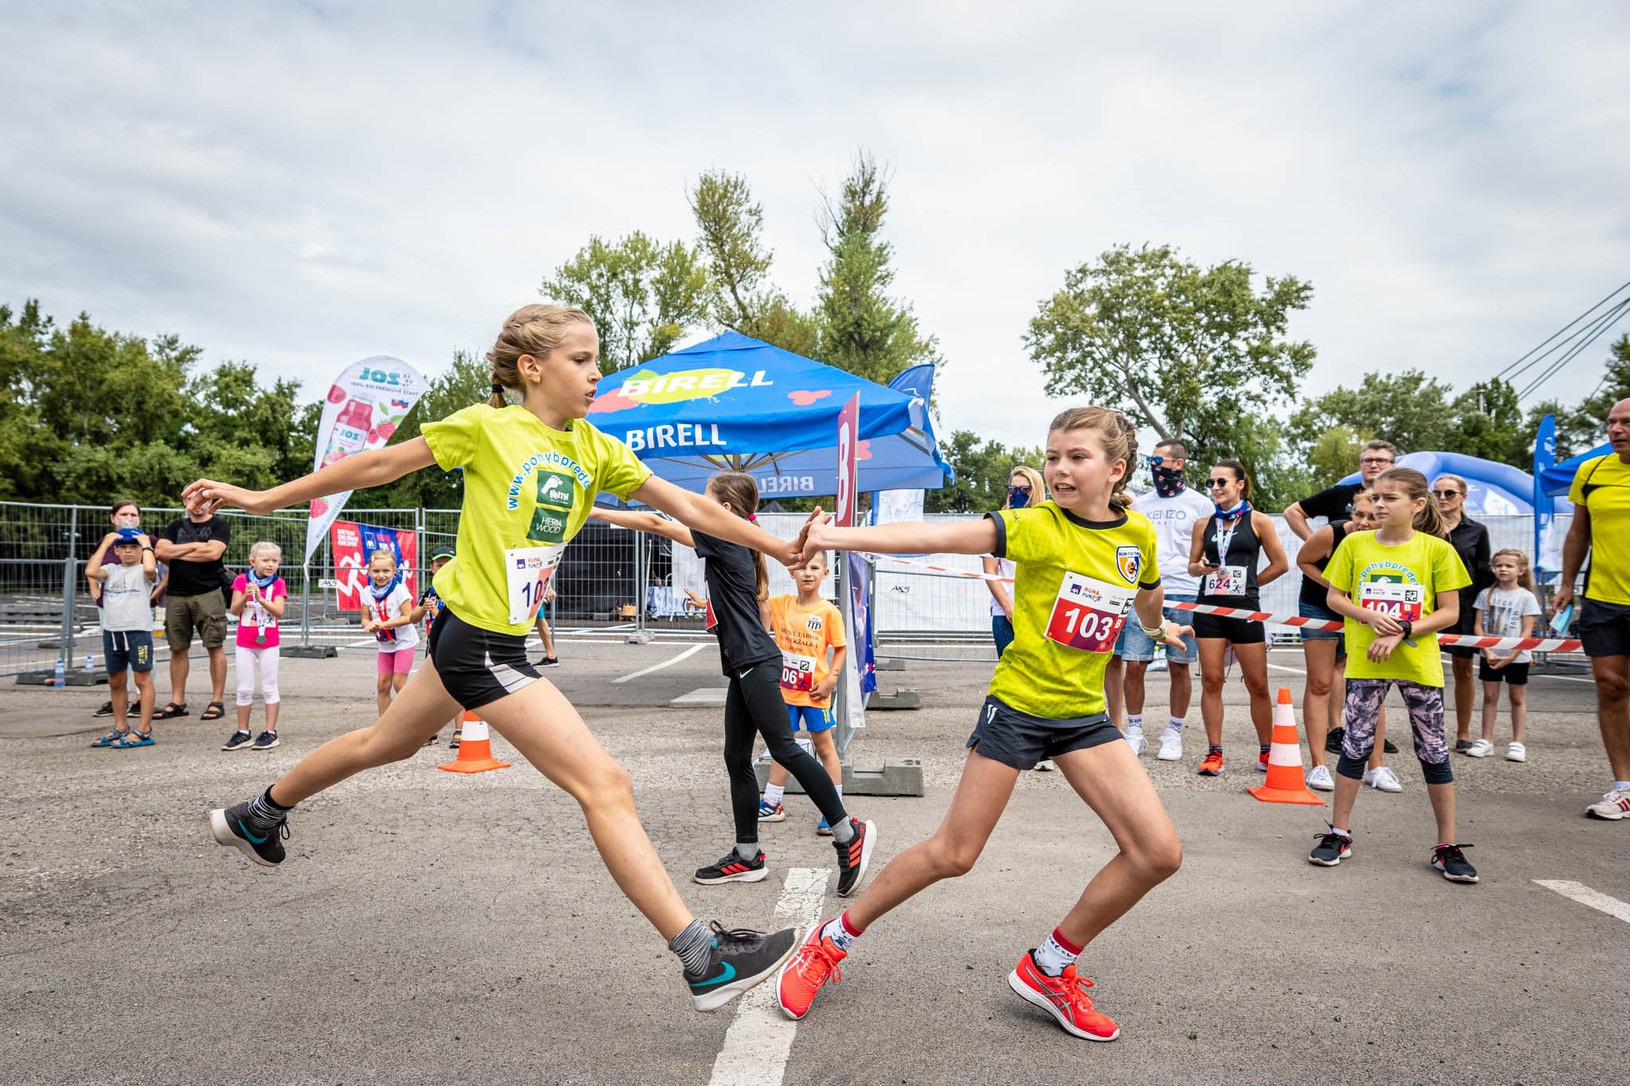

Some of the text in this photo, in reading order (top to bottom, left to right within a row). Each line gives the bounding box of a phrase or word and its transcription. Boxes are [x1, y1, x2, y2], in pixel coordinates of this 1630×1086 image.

[617, 370, 774, 397] BIRELL
[626, 423, 727, 451] BIRELL
[838, 422, 850, 522] B
[541, 517, 562, 527] HERN
[1146, 510, 1186, 520] KENZO
[535, 523, 561, 533] WOOD
[1208, 579, 1231, 589] 624
[1065, 608, 1122, 641] 103 B
